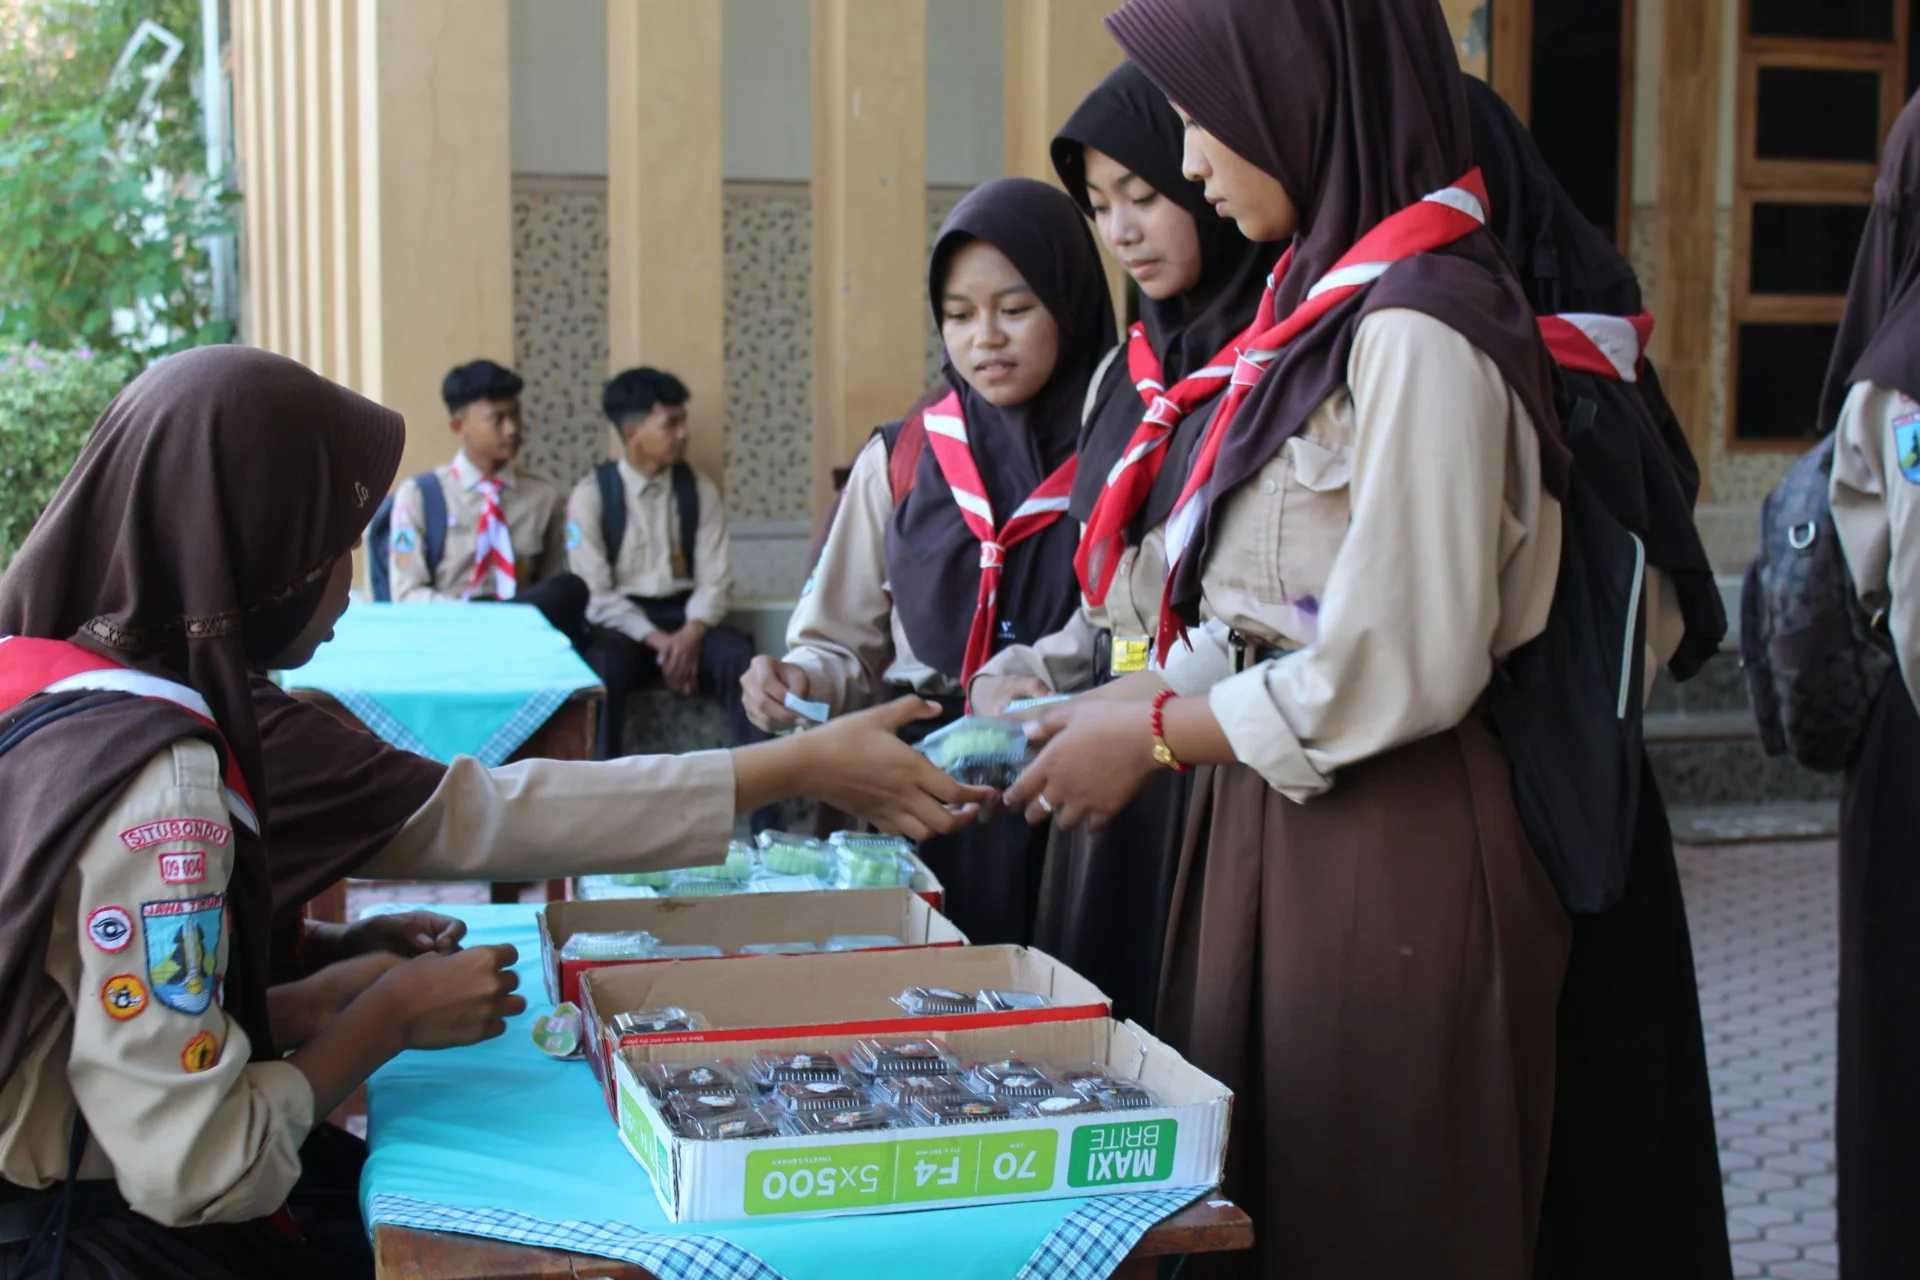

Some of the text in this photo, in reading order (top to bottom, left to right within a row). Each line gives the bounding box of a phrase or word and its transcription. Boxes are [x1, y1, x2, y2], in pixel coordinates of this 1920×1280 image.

[128, 821, 225, 845] SITUBONDO
[1089, 1125, 1160, 1151] BRITE
[913, 1156, 961, 1187] F4
[993, 1150, 1038, 1181] 70
[1087, 1147, 1157, 1182] MAXI
[762, 1164, 881, 1201] 5x500
